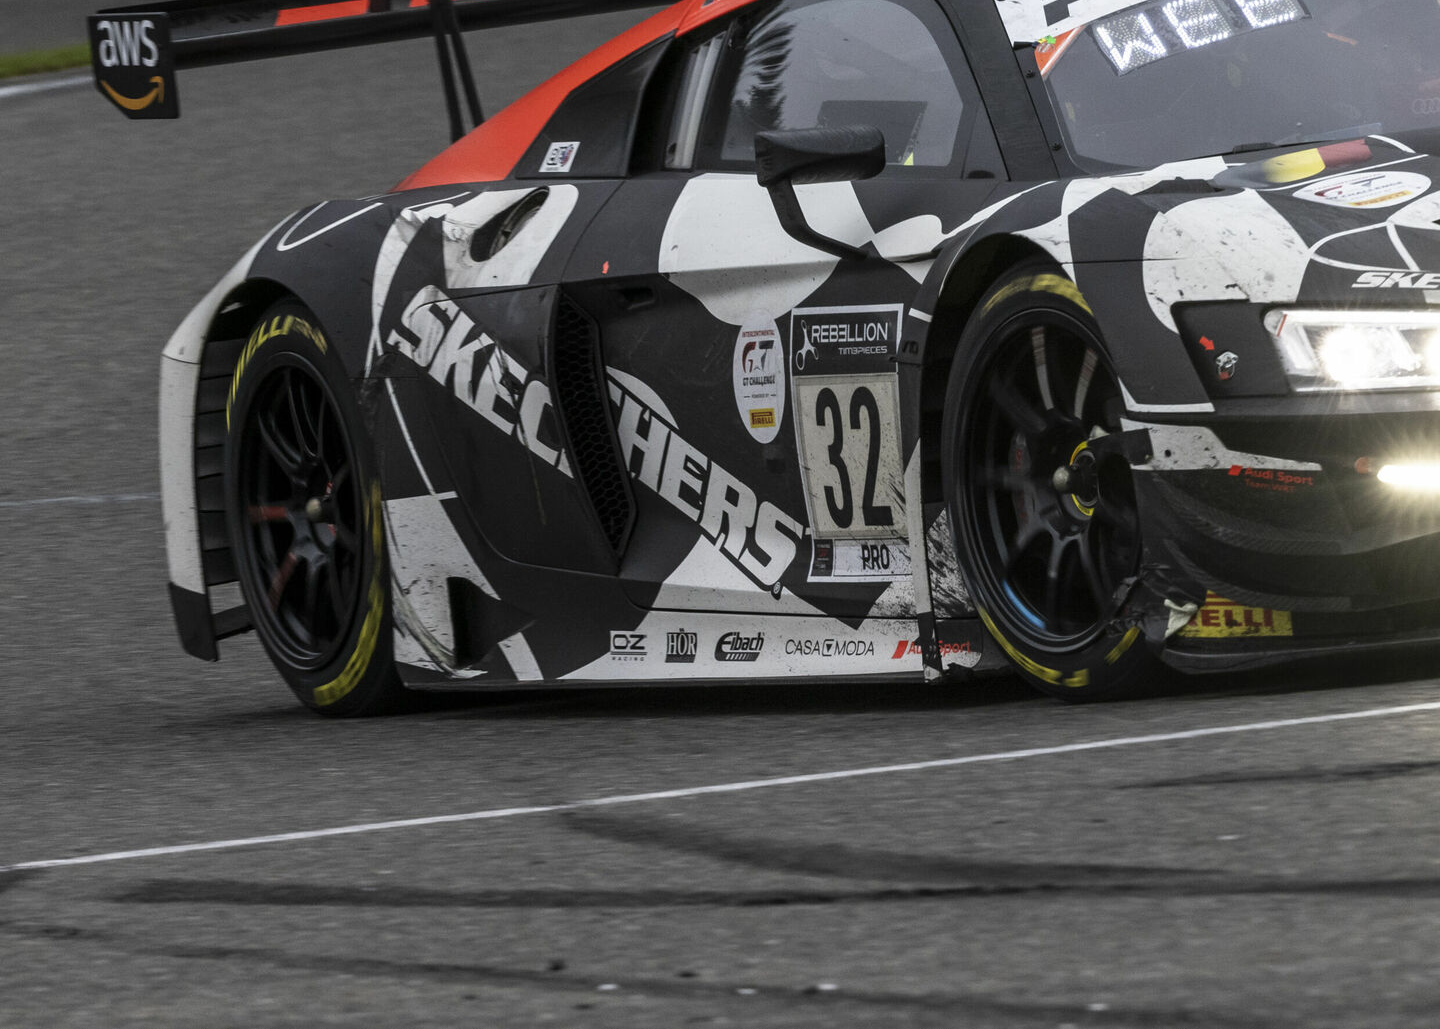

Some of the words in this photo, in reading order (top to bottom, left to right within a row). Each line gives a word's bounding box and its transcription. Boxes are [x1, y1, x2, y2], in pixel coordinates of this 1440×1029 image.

[97, 19, 159, 67] aws
[811, 322, 889, 343] REBELLION
[815, 386, 894, 529] 32
[1244, 466, 1274, 480] Audi
[1277, 471, 1314, 487] Sport
[861, 544, 890, 570] PRO
[612, 634, 647, 650] OZ
[714, 632, 764, 661] Eibach
